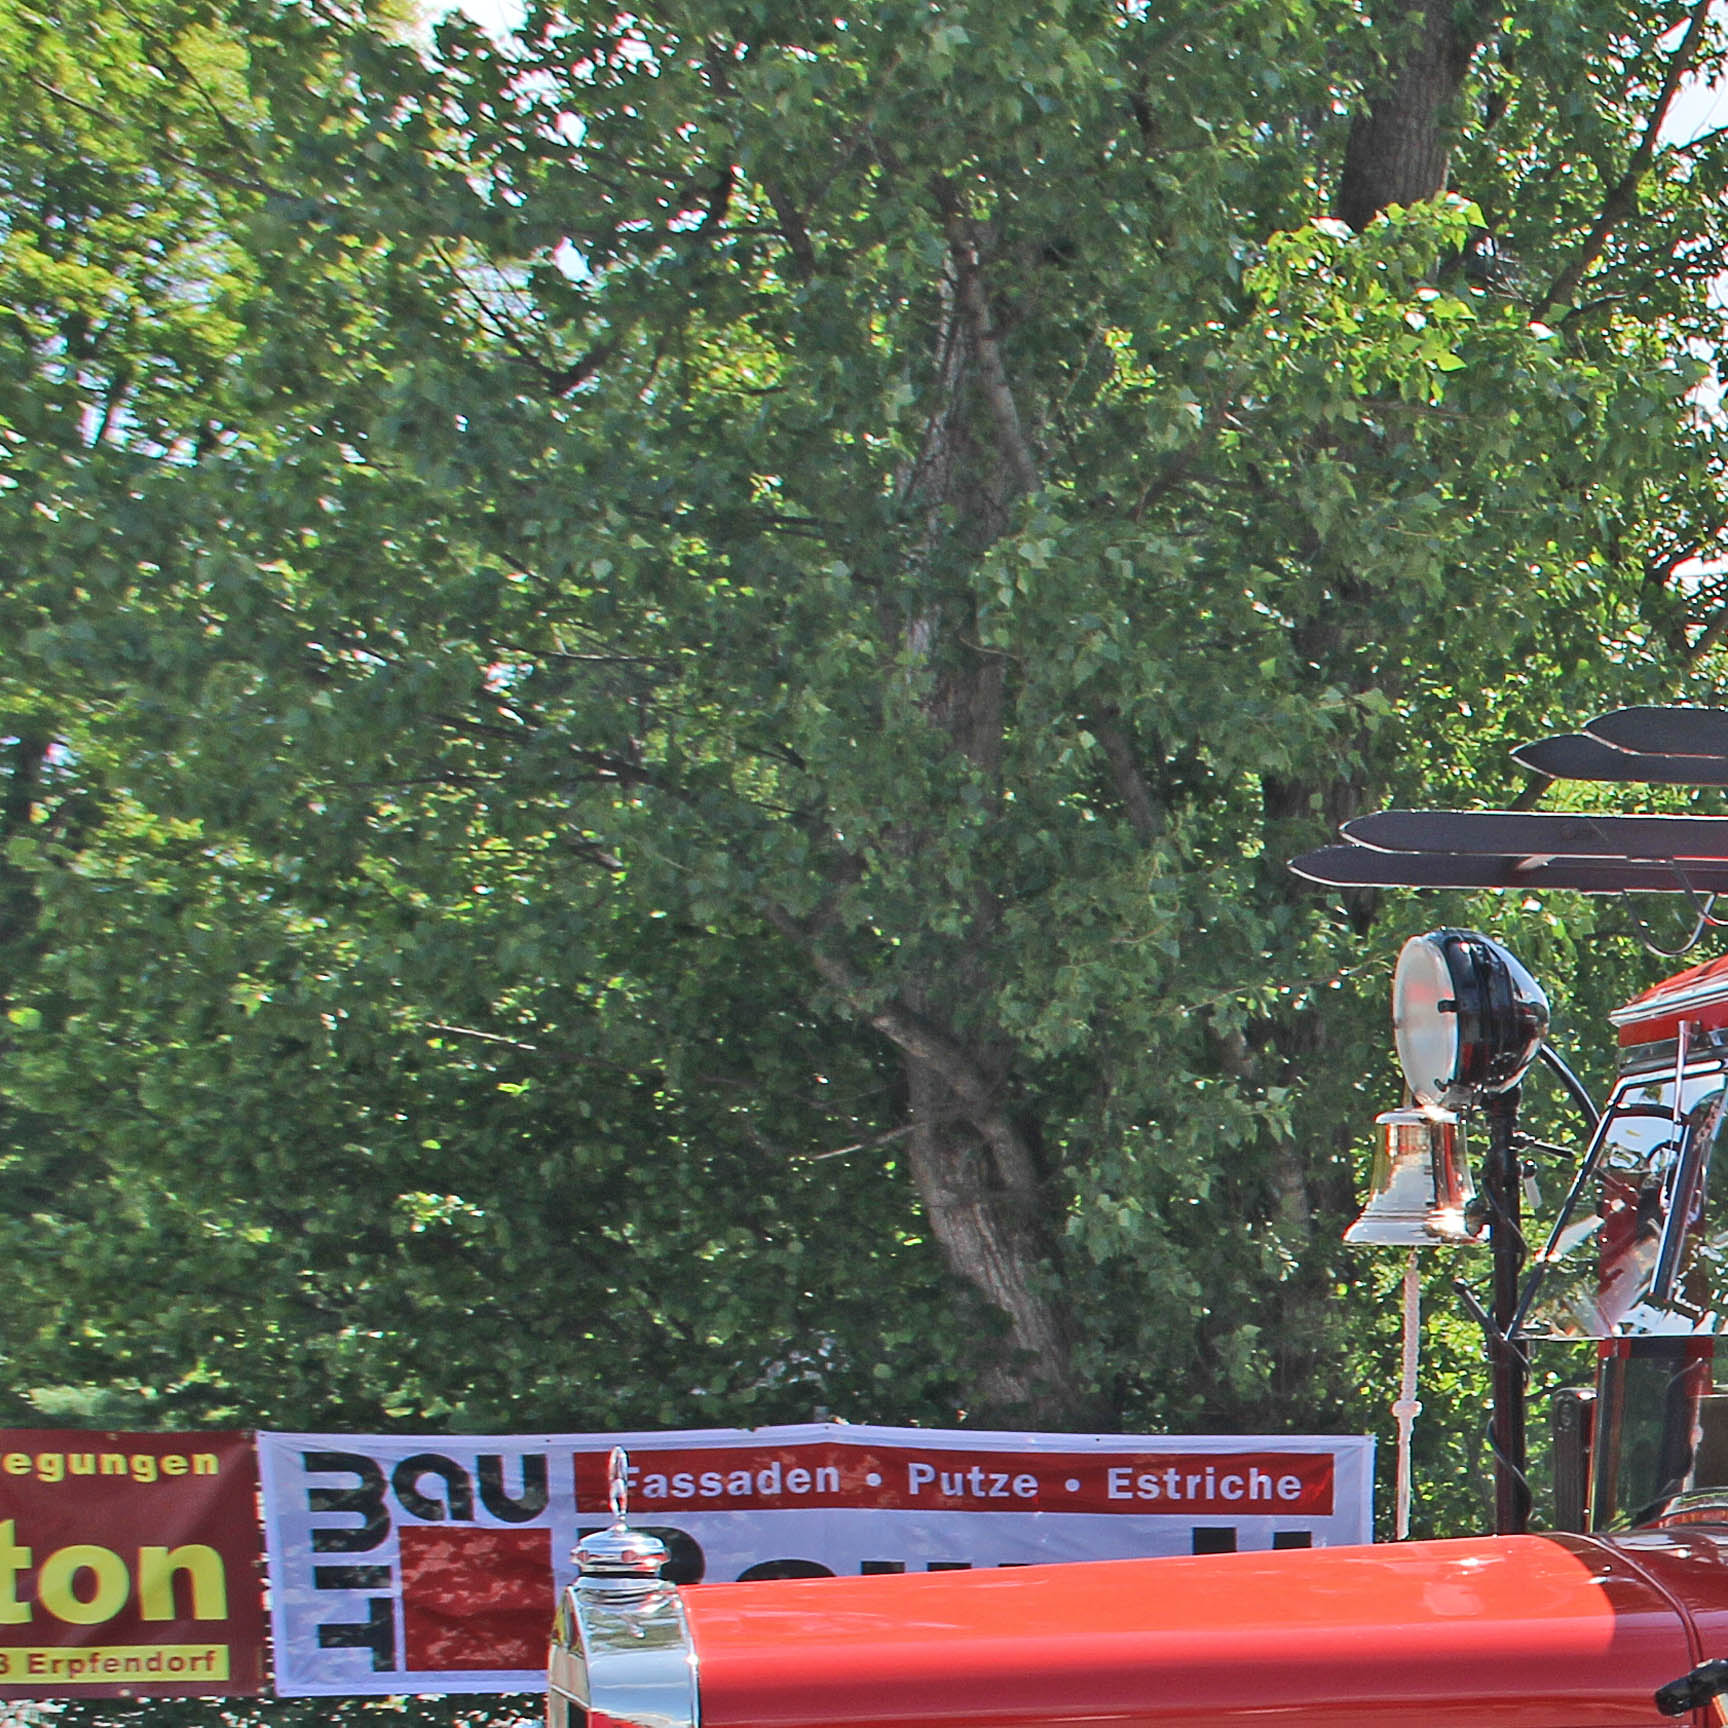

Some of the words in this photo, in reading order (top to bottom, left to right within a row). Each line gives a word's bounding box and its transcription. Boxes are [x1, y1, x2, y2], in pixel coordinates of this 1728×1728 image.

[0, 1453, 219, 1482] egungen
[908, 1463, 1038, 1498] Putze
[1107, 1467, 1301, 1500] Estriche
[27, 1650, 216, 1679] Erpfendorf
